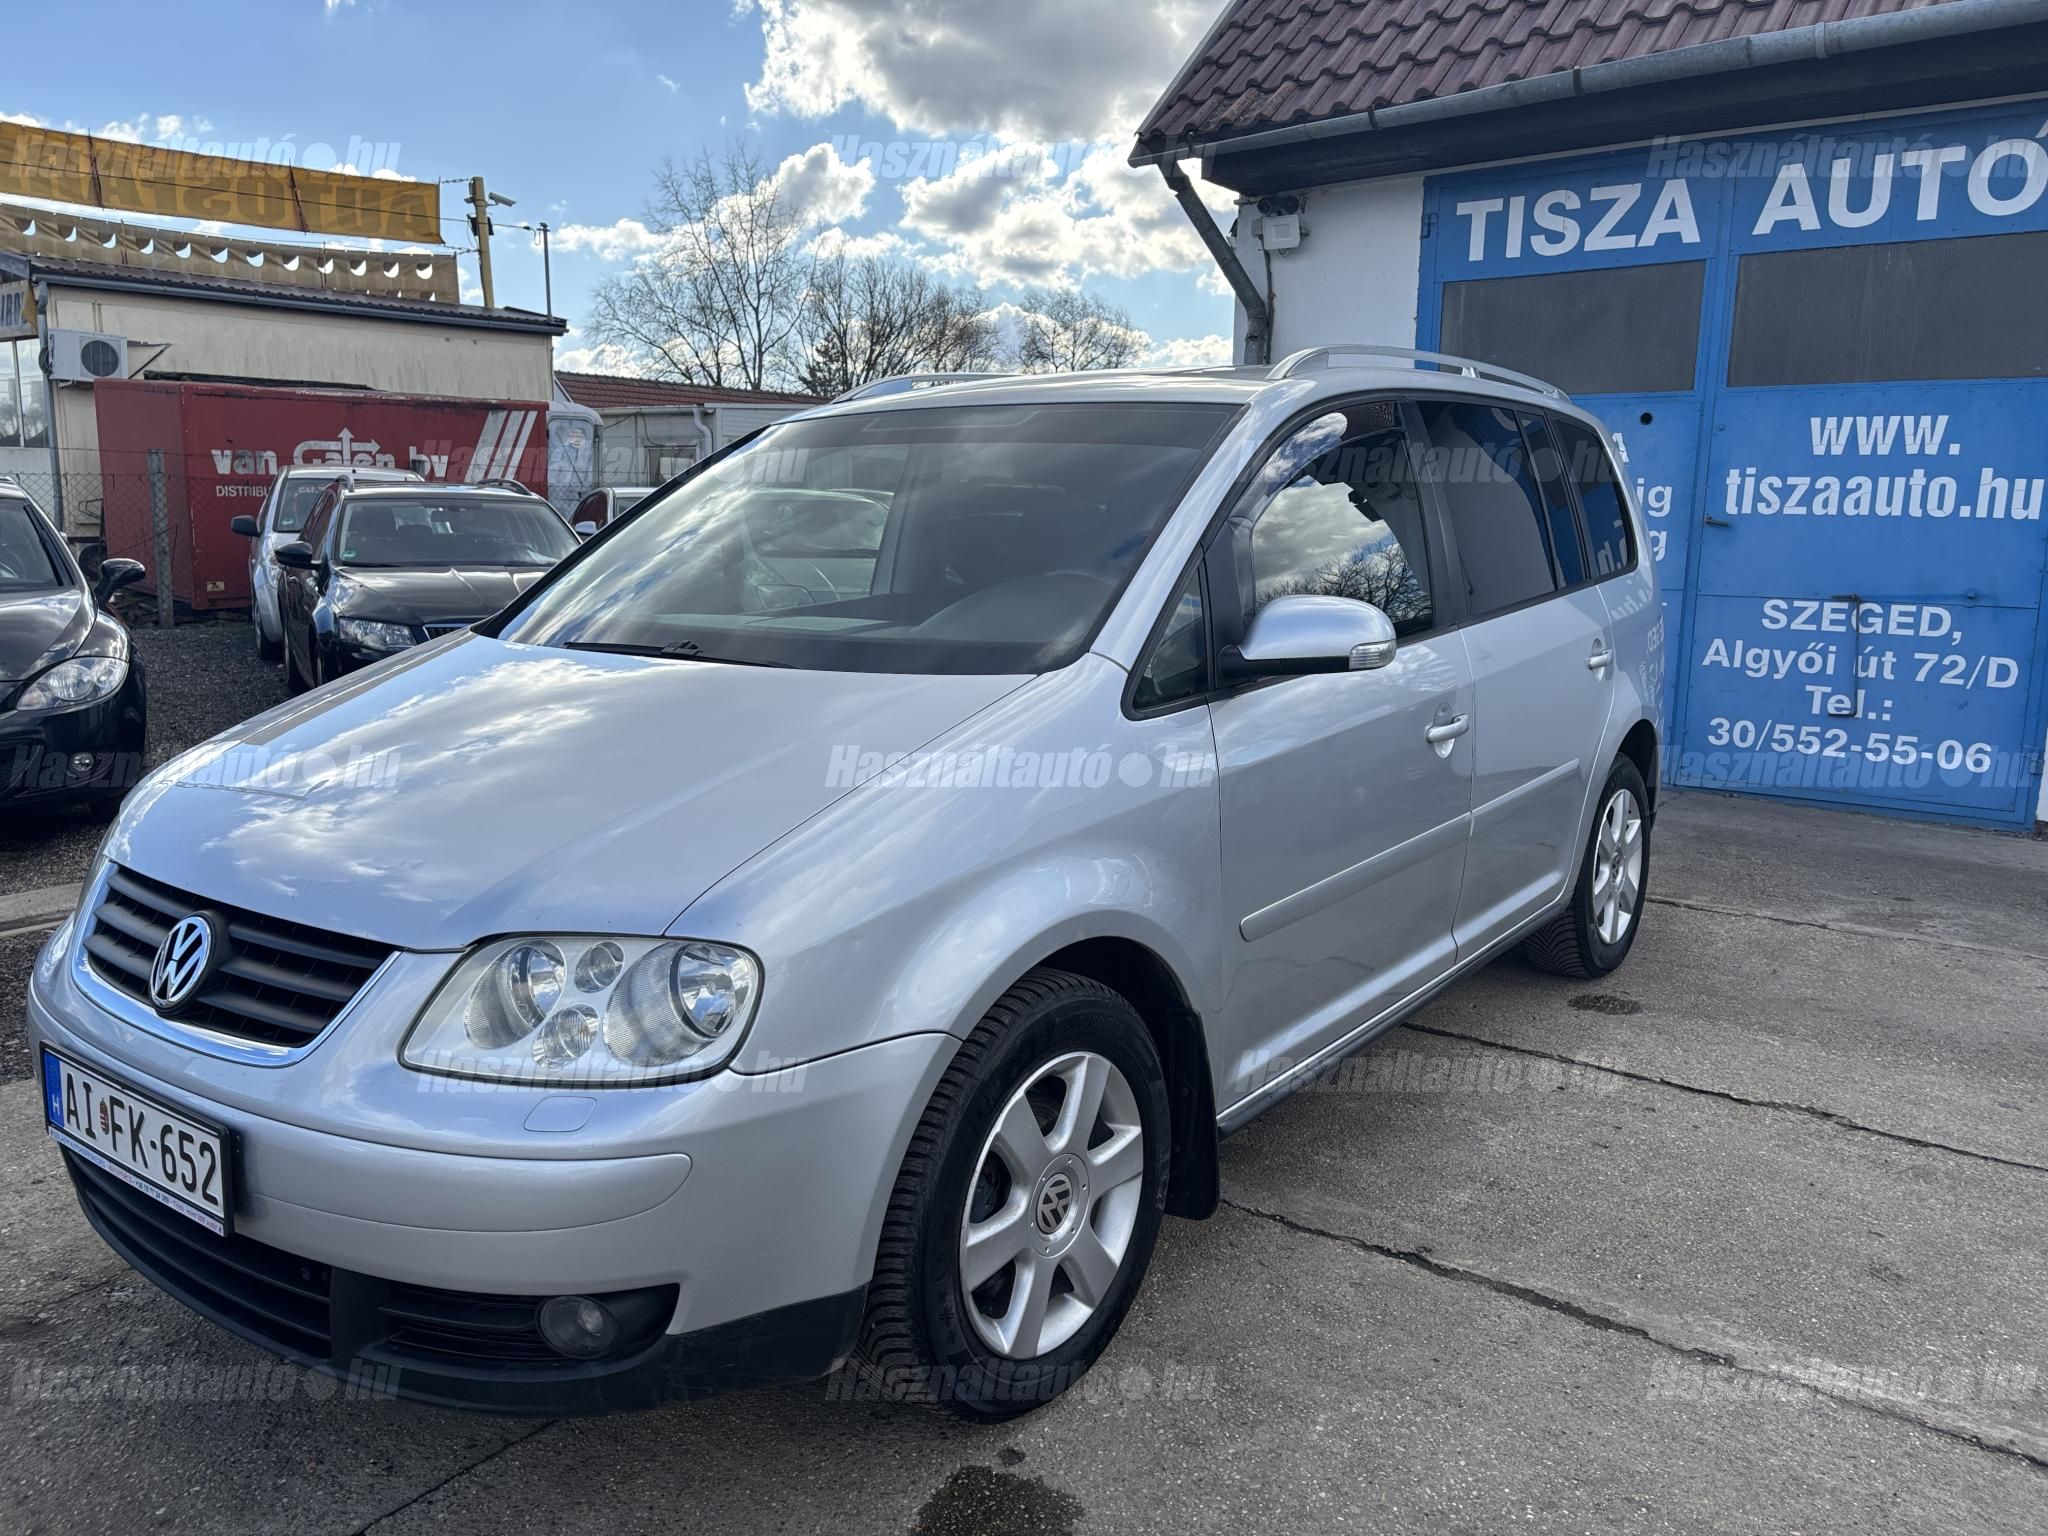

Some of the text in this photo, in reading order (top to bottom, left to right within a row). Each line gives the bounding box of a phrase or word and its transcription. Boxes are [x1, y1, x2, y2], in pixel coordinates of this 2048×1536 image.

[1456, 117, 2048, 262] TISZA AUTÓ
[1810, 415, 1960, 455] www.
[210, 449, 278, 475] van
[216, 485, 272, 498] DISTRIBU
[1725, 467, 2045, 520] tiszaauto.hu
[1761, 599, 1962, 645] SZEGED,
[1702, 638, 1837, 680] Algyői
[1854, 646, 1897, 681] út
[1913, 653, 2019, 690] 72/D
[1805, 685, 1893, 721] Tel.:
[1708, 717, 1993, 774] 30/552-55-06
[67, 1072, 218, 1206] AI FK-652
